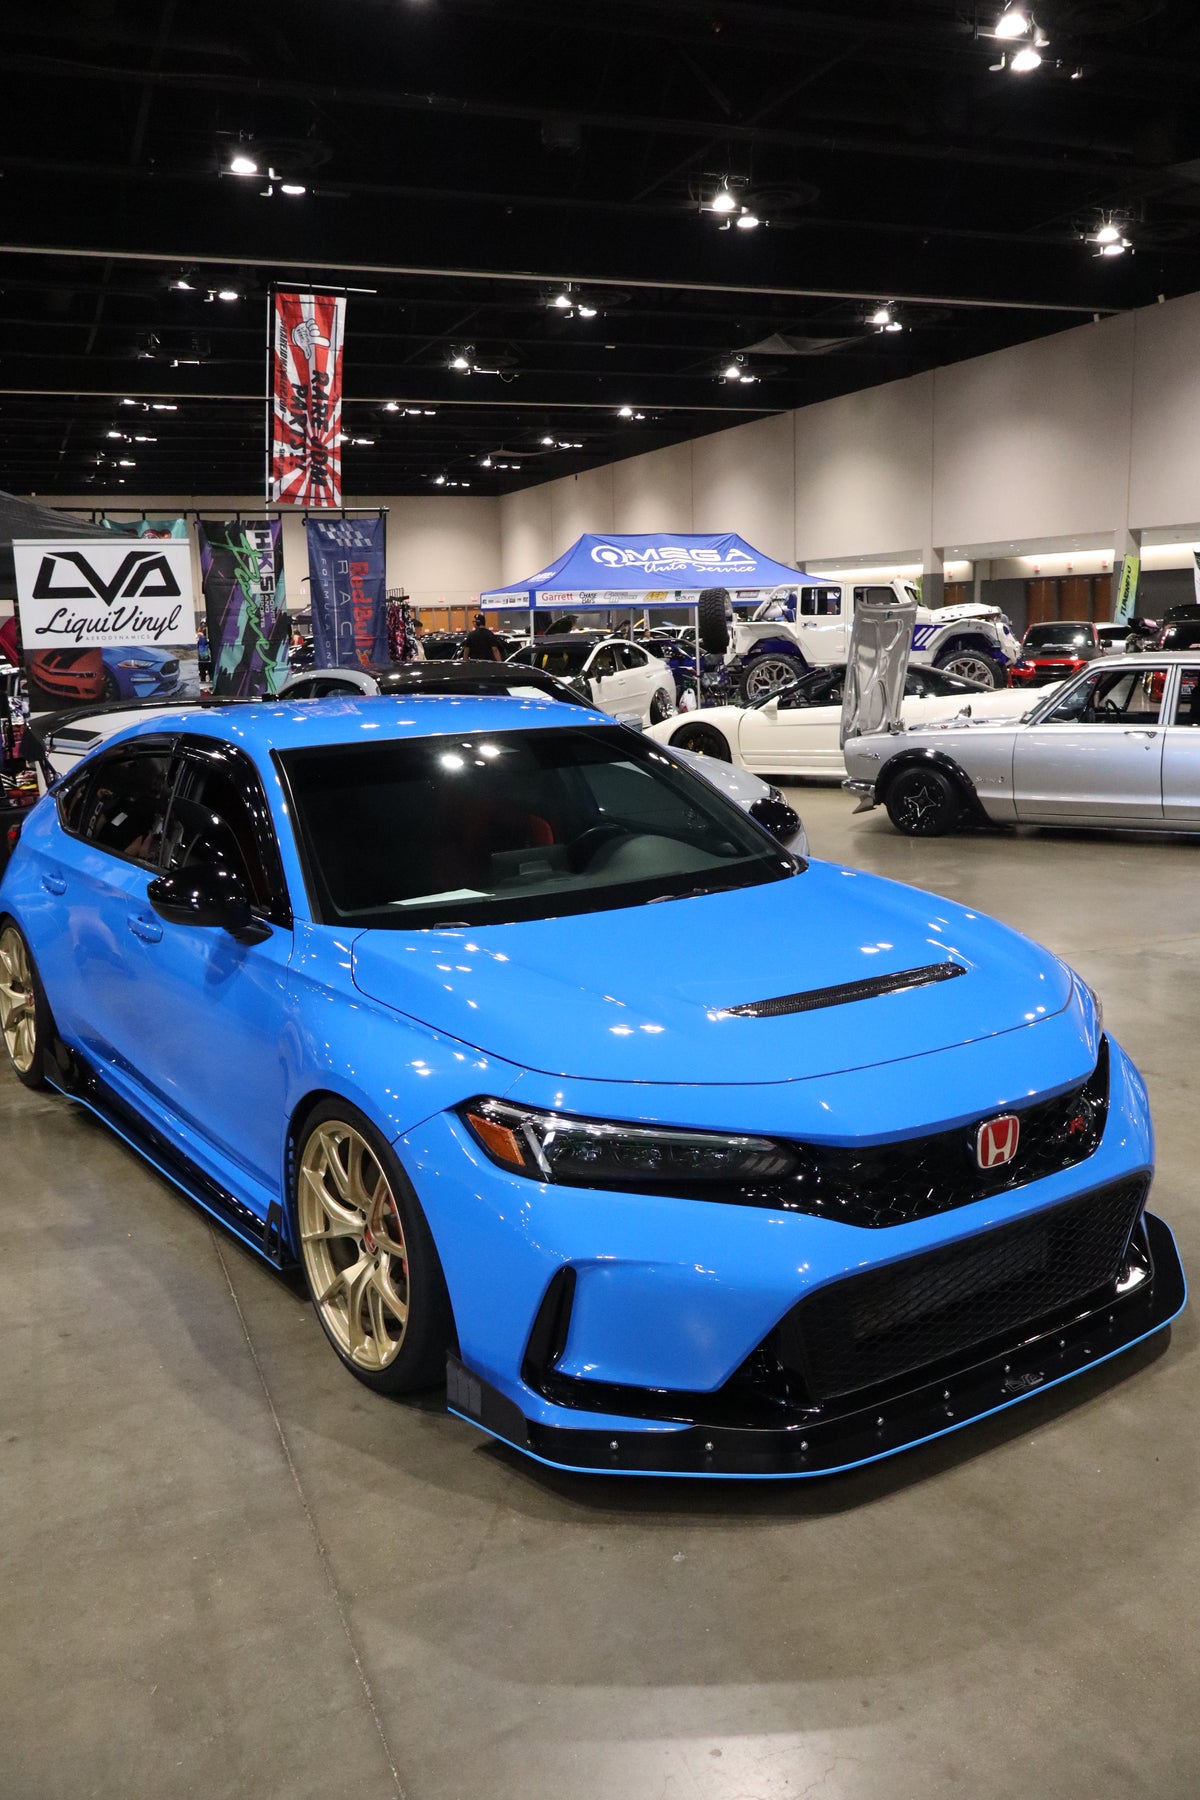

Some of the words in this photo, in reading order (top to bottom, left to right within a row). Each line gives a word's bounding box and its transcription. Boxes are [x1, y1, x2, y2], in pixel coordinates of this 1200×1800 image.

[311, 370, 329, 432] RARE
[311, 436, 328, 486] JDM
[254, 531, 274, 592] HKS
[644, 561, 687, 573] Auto
[692, 563, 756, 572] Service
[321, 558, 331, 630] FORMULA
[349, 562, 372, 603] Red
[541, 592, 573, 601] Garrett
[35, 604, 182, 642] LiquiVinyl
[353, 606, 374, 646] Bull
